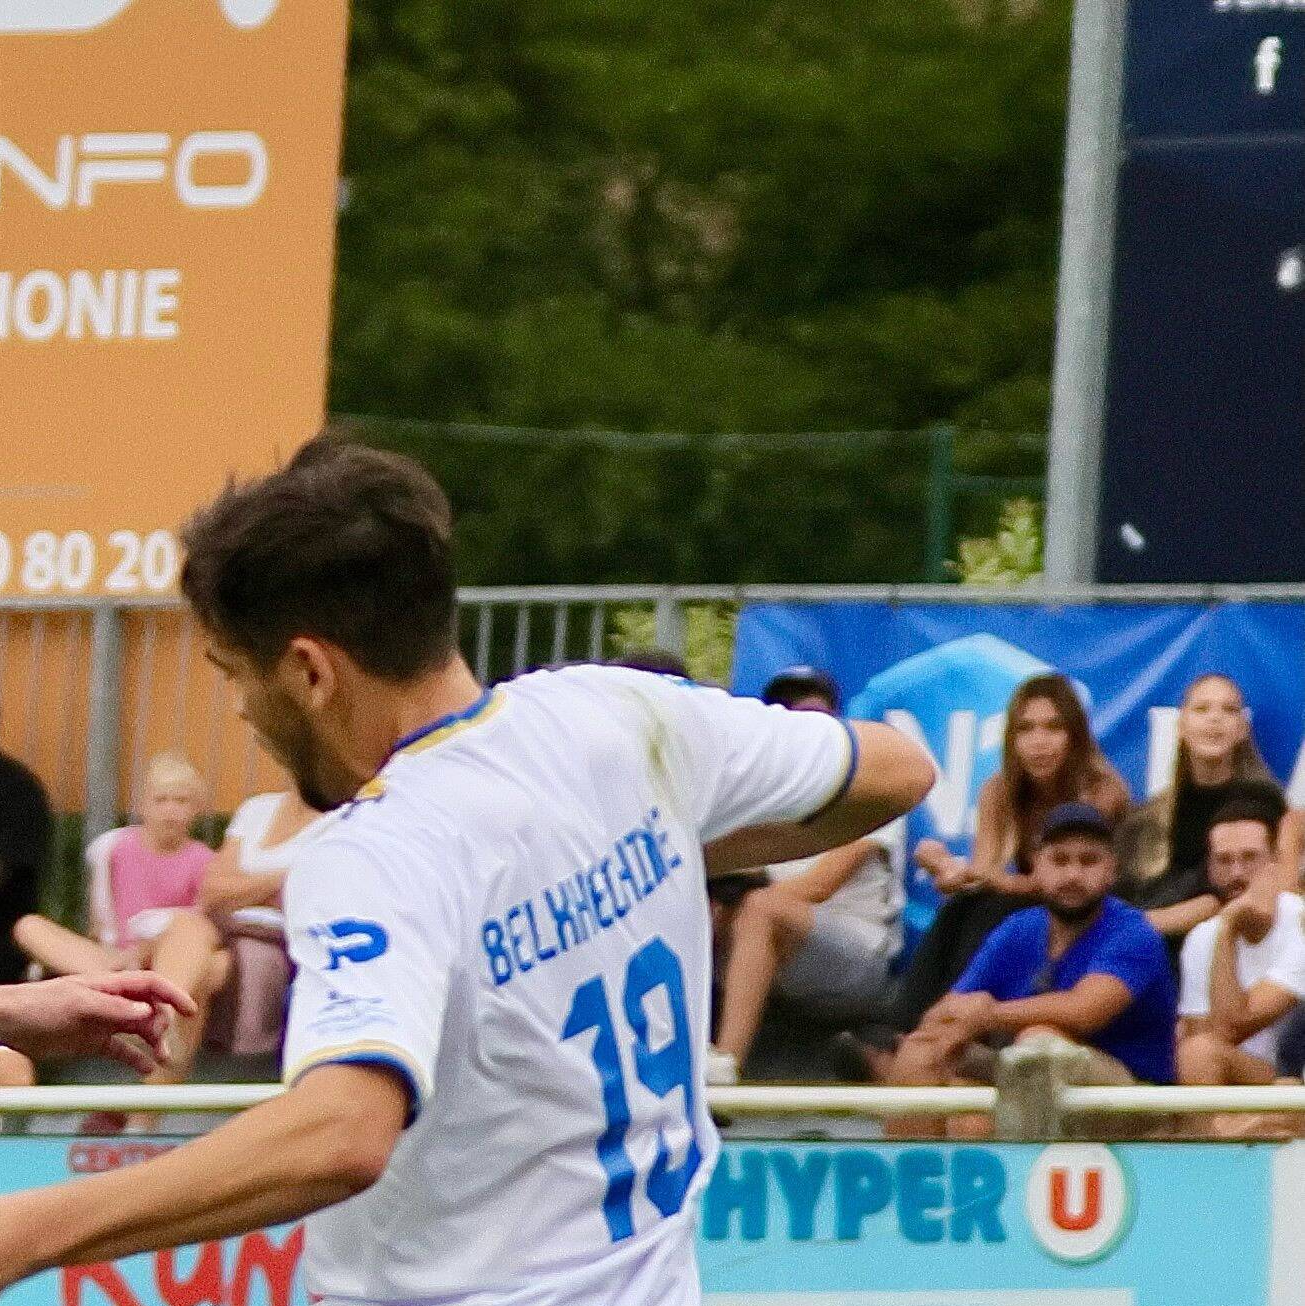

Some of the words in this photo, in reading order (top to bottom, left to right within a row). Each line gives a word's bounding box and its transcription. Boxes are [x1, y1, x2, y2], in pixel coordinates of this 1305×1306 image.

[20, 530, 93, 590] 80
[104, 529, 177, 590] 20
[562, 936, 703, 1242] 19
[702, 1147, 1008, 1245] HYPER
[1048, 1168, 1104, 1231] U
